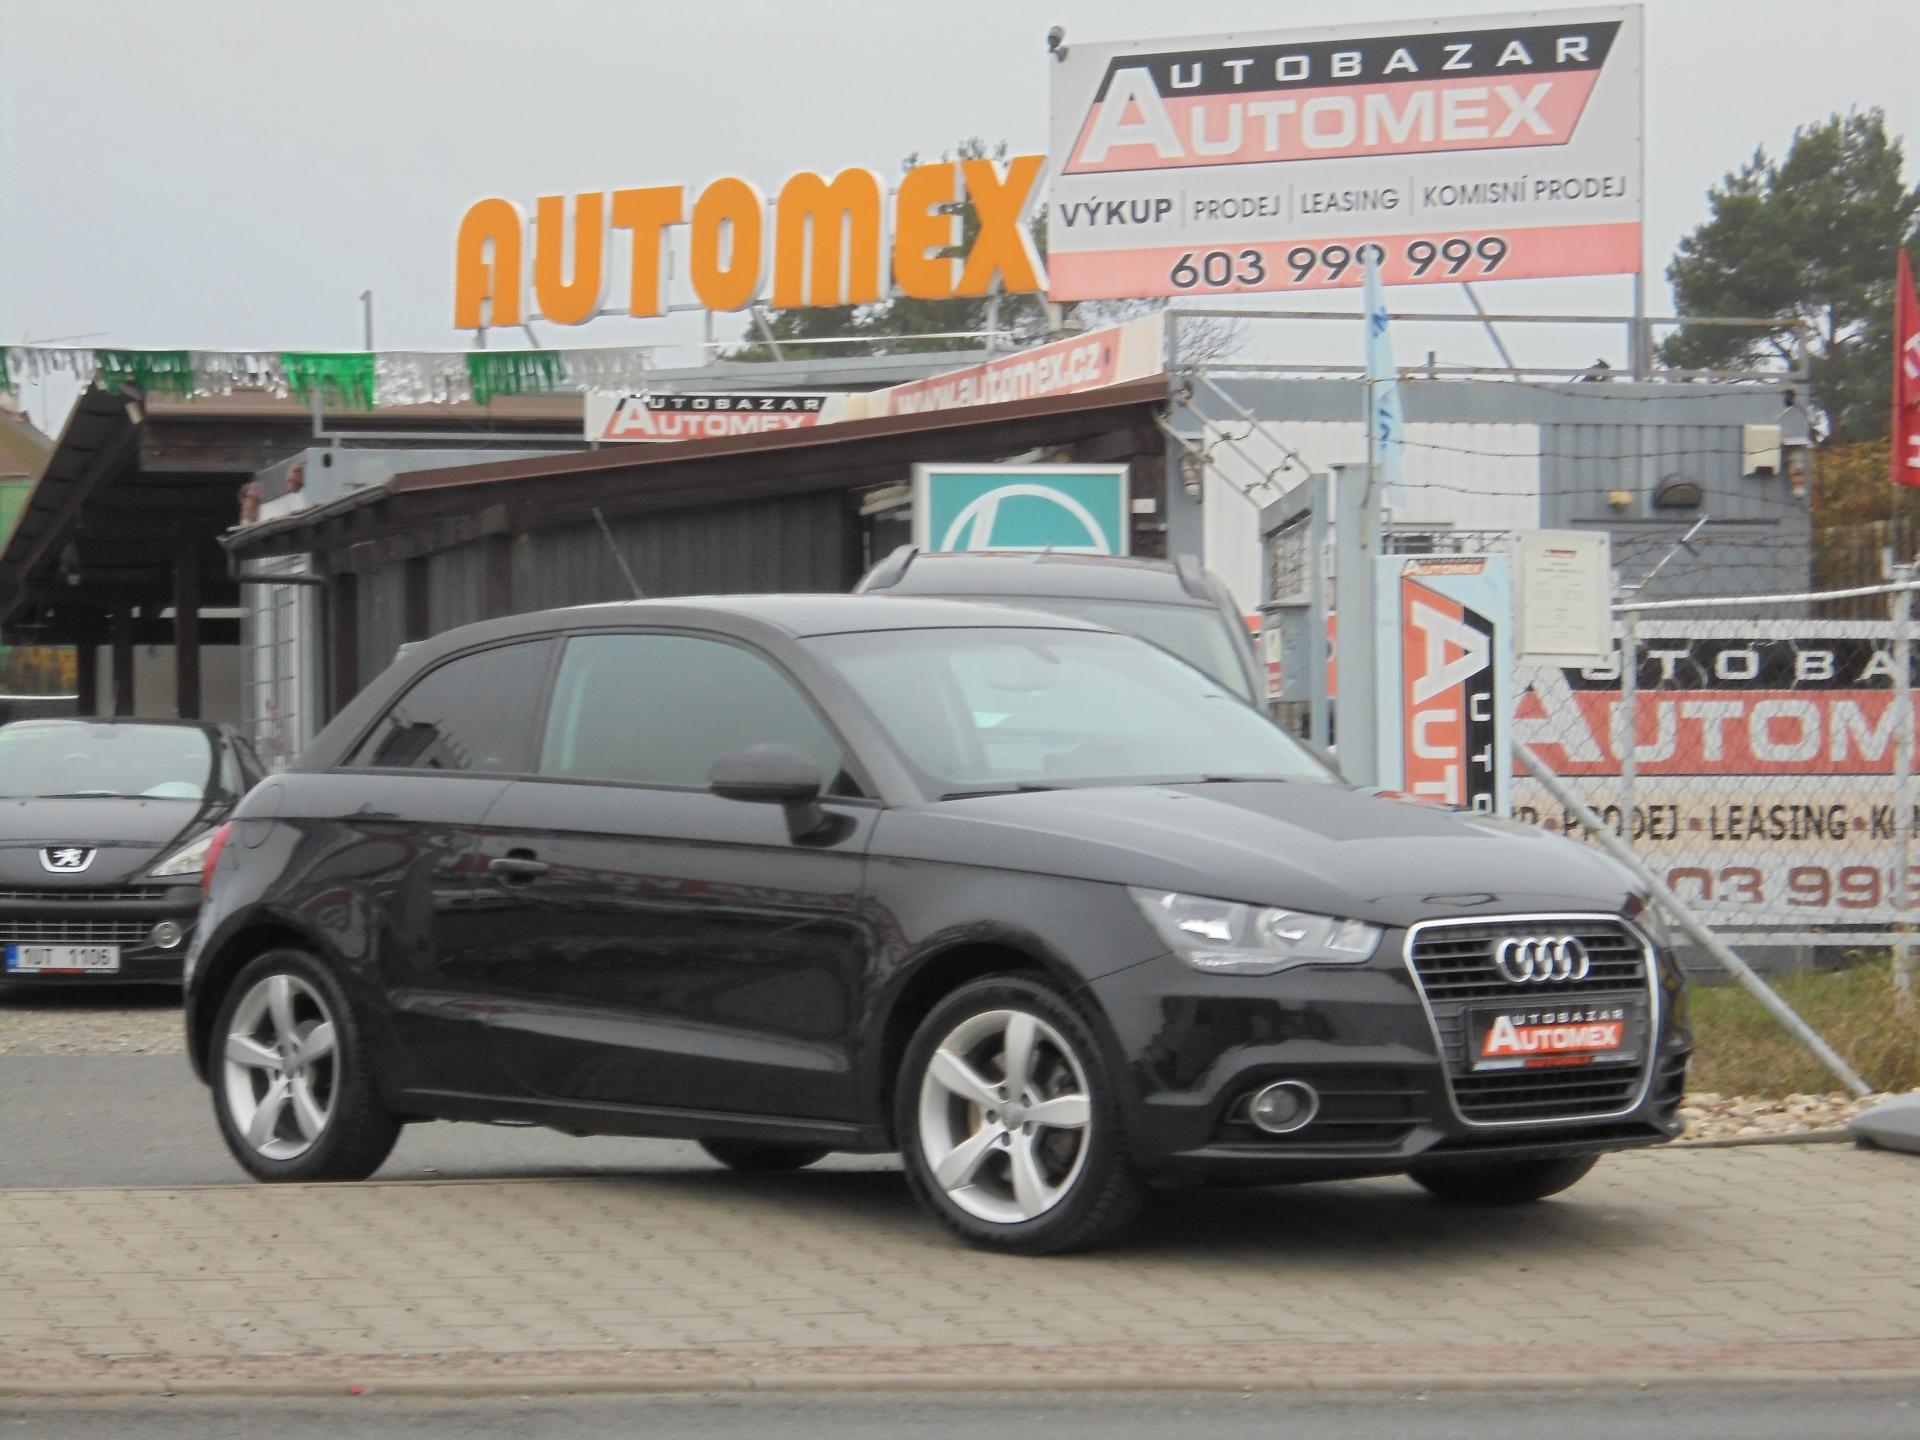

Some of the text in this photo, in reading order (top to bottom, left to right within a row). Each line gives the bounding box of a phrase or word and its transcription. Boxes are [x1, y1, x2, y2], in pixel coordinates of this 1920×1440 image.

[1078, 66, 1555, 166] AUTOMEX
[1060, 174, 1626, 227] VÝKUP PRODEJ LEASING KOMISNÍ PRODEJ
[454, 154, 1049, 330] AUTOMEX
[1170, 249, 1265, 289] 603
[1407, 236, 1508, 276] 999
[1711, 804, 1847, 840] LEASING
[1488, 1016, 1617, 1052] AUTOMEX
